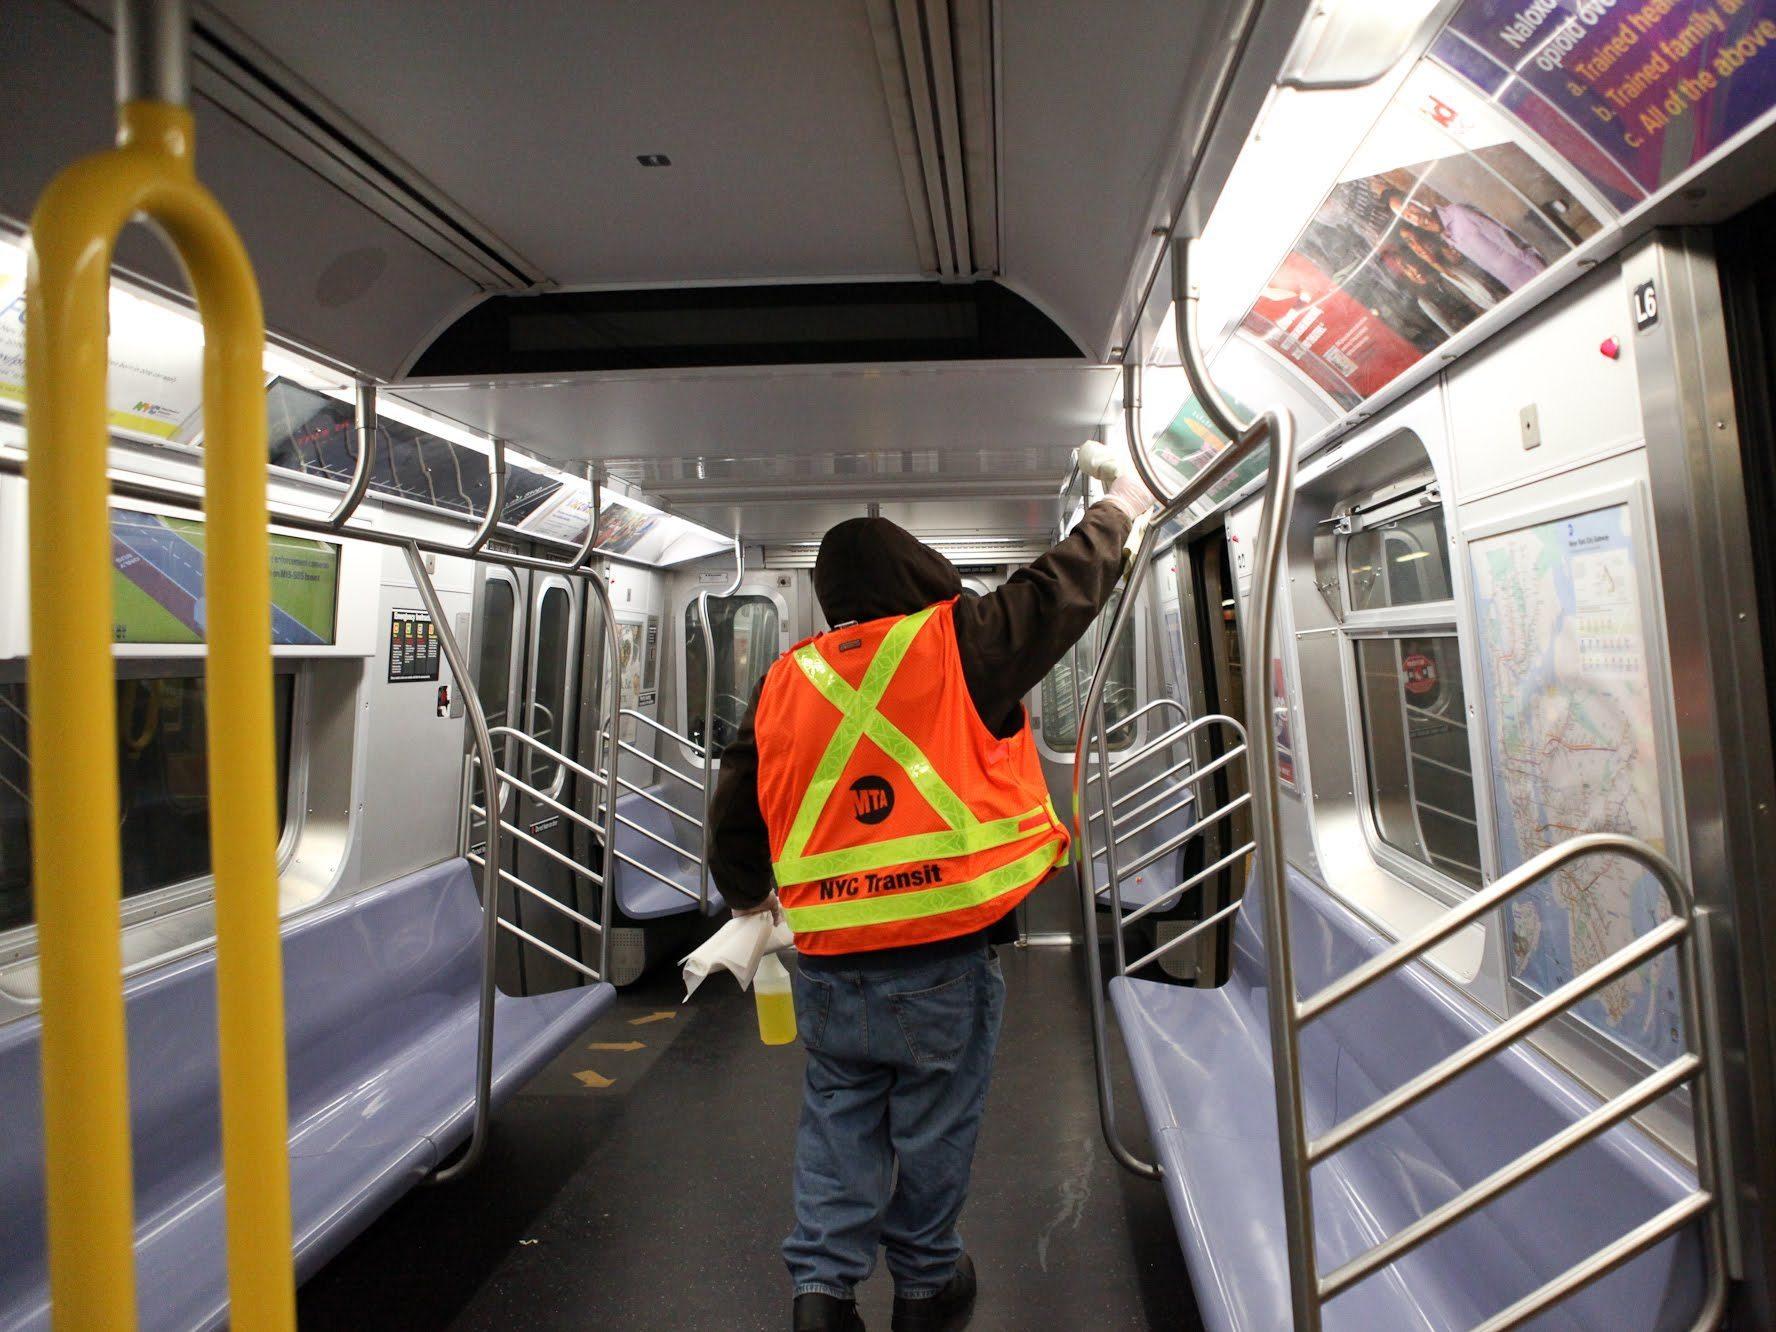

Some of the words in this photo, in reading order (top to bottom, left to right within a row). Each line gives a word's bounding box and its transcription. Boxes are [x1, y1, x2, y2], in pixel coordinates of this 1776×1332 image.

[1627, 0, 1675, 32] hea
[1575, 23, 1639, 81] Trained
[1592, 104, 1616, 122] b.
[1605, 50, 1670, 108] Trained
[1659, 7, 1725, 62] family
[1567, 81, 1588, 97] a.
[1624, 132, 1644, 147] c.
[1639, 105, 1670, 134] All
[1664, 88, 1687, 115] of
[1677, 71, 1717, 101] the
[1714, 20, 1776, 77] above
[1634, 287, 1657, 323] L6
[853, 788, 889, 816] MTA
[820, 877, 859, 900] NYC
[865, 864, 943, 894] Transit
